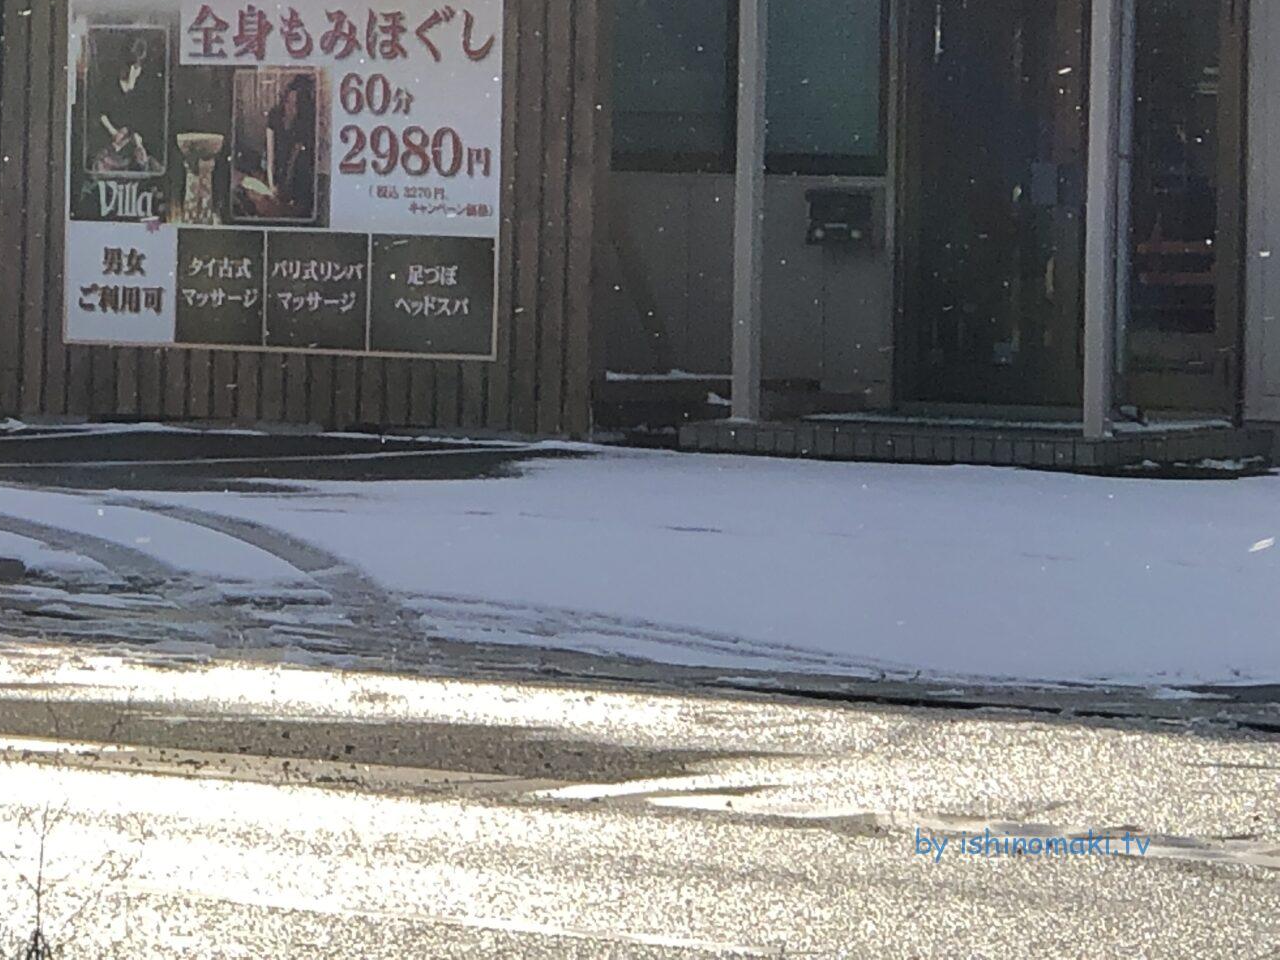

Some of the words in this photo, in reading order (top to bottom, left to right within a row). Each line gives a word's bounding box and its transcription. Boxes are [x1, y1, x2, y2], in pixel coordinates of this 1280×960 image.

[187, 2, 497, 62] 全身もみほぐし
[339, 72, 415, 116] 60分
[339, 124, 492, 178] 2980円
[98, 180, 153, 218] Villa
[102, 246, 147, 277] 男女
[189, 257, 253, 279] タイ古式
[78, 283, 164, 316] ご利用可
[181, 287, 259, 309] マッサージ
[277, 291, 357, 313] マッサージ
[395, 295, 470, 317] ヘッドスパ
